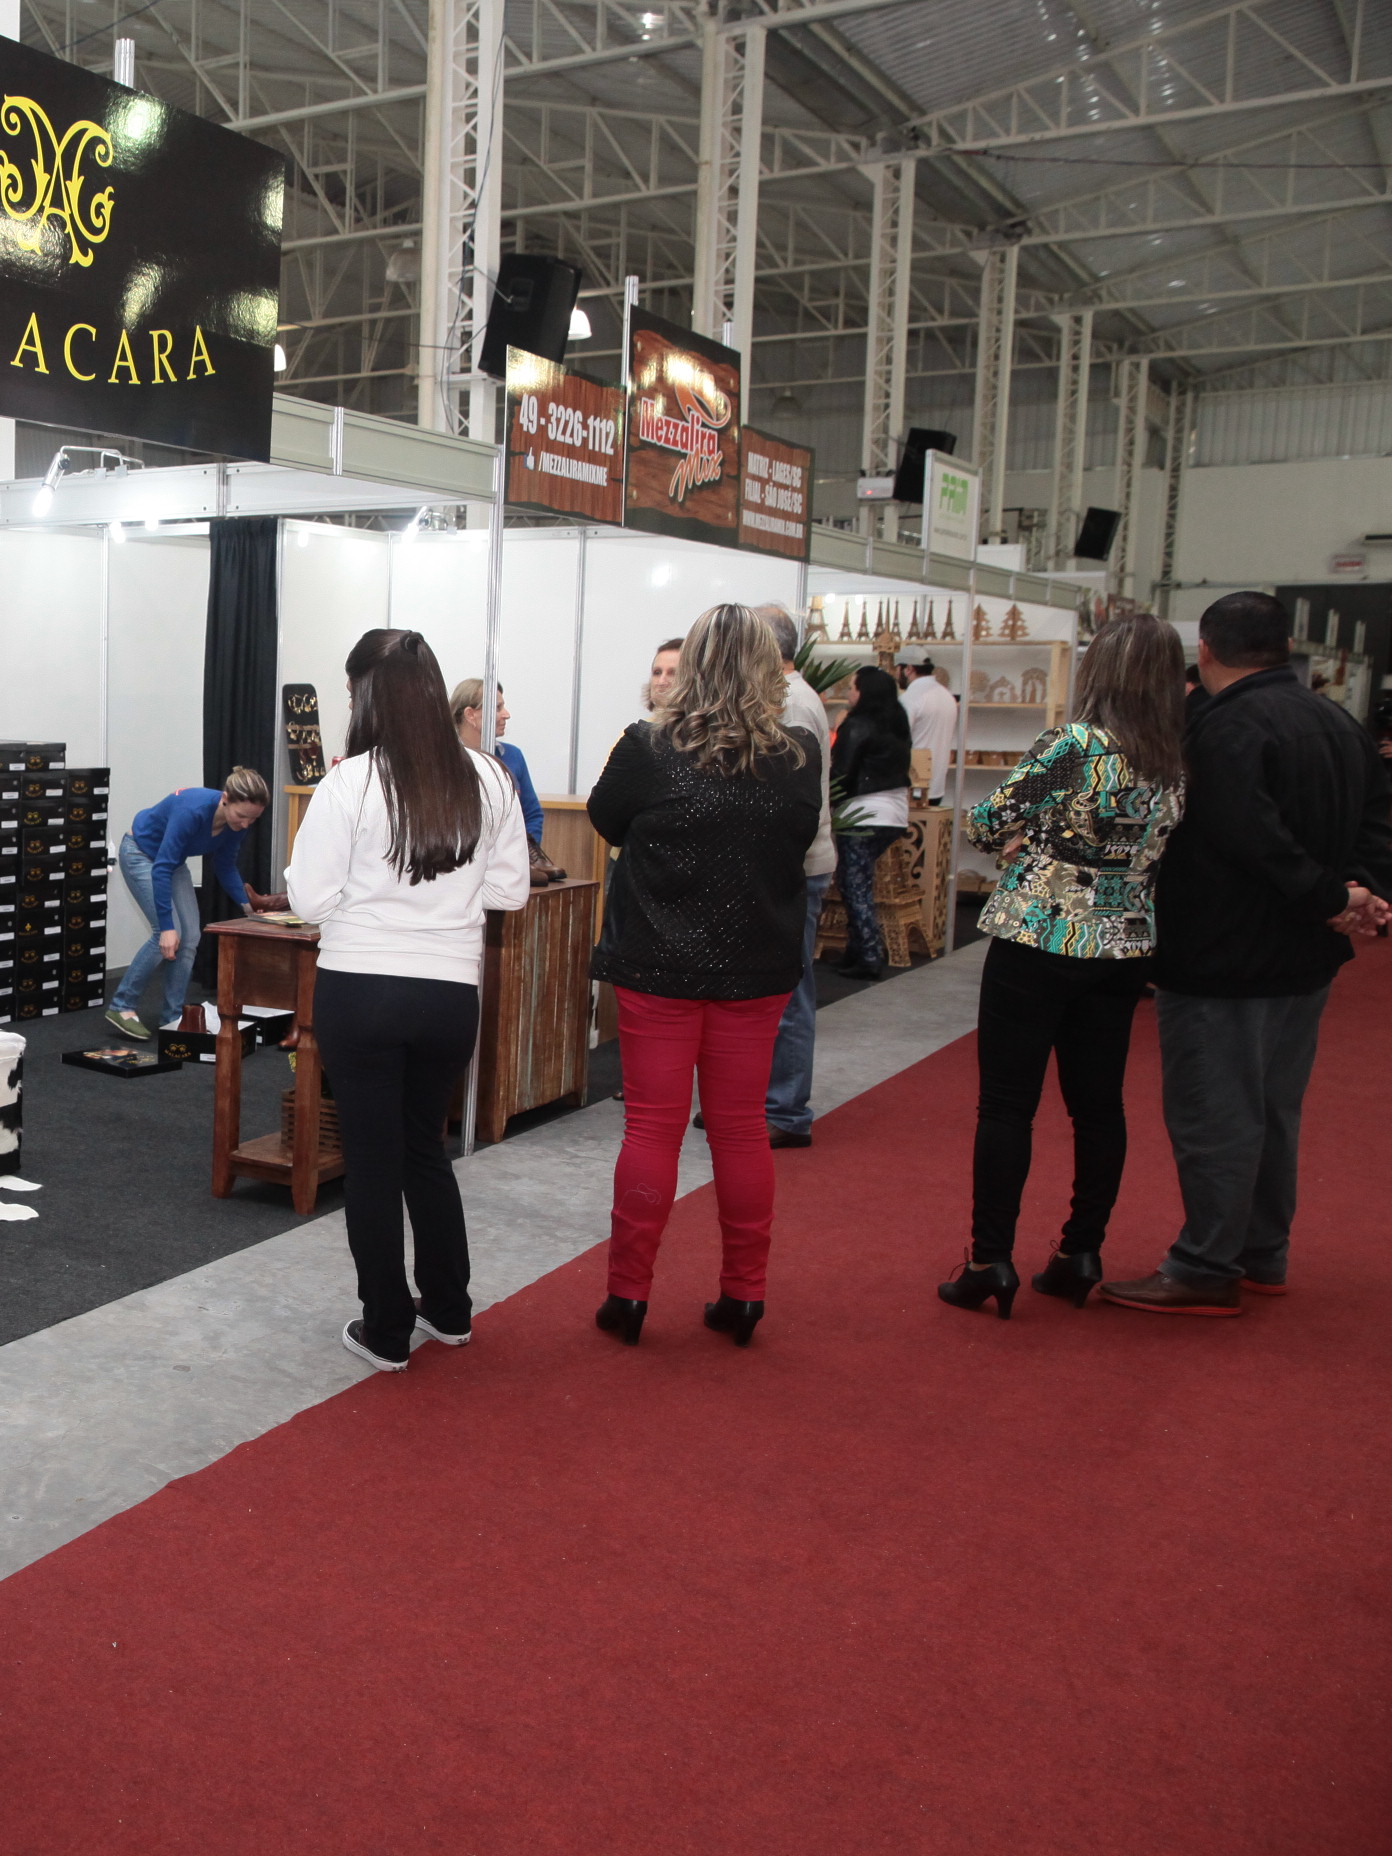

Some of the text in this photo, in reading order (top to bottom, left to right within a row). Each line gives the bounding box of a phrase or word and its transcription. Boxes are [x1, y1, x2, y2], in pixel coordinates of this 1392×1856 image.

[519, 392, 538, 435] 49
[547, 401, 615, 456] 3226-1112
[639, 397, 718, 456] Mezzalira
[669, 448, 724, 502] Mix
